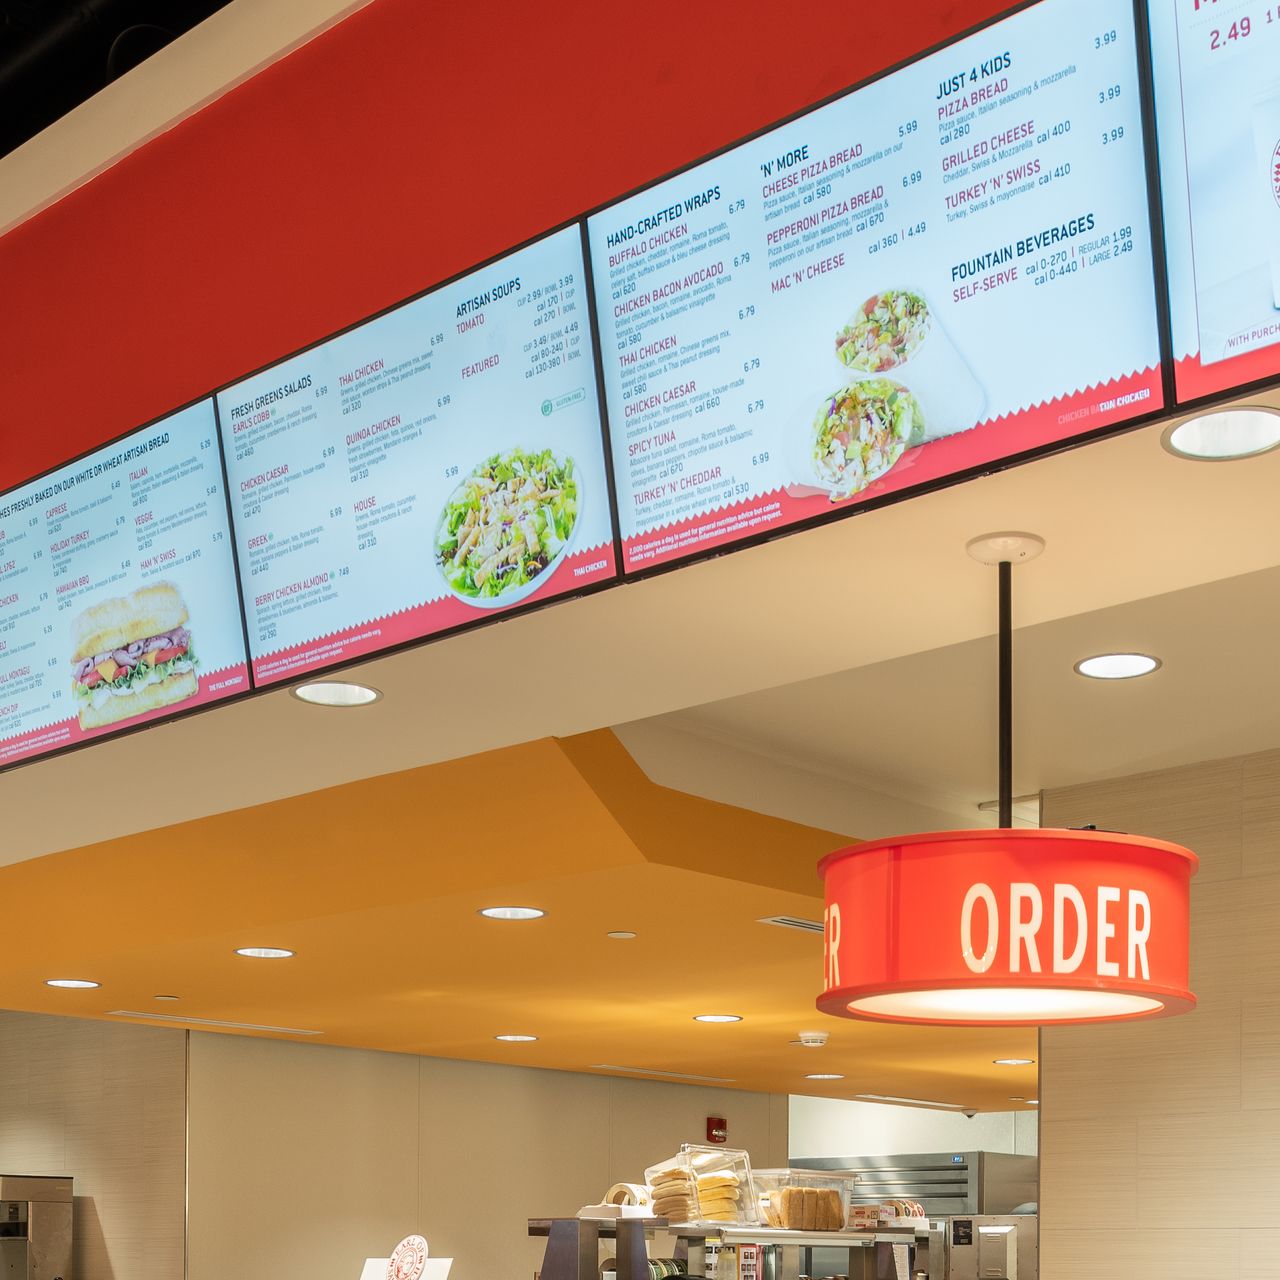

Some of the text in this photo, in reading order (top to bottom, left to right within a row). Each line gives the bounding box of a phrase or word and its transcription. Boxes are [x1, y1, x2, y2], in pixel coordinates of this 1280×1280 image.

[1210, 16, 1251, 50] 2.49
[1266, 10, 1273, 24] 1
[935, 50, 1011, 100] JUST 4 KIDS
[937, 29, 1117, 121] PIZZA BREAD 3.99
[761, 119, 918, 199] CHEESE PIZZA BREAD 5.99
[776, 144, 809, 172] MORE
[941, 84, 1121, 172] GRILLED CHEESE 3.99
[944, 180, 988, 211] TURKEY
[1005, 158, 1041, 185] SWISS
[1101, 125, 1124, 145] 3.99
[606, 184, 721, 250] HAND-CRAFTED WRAPS
[608, 198, 745, 268] BUFFALO CHICKEN 6.79
[766, 169, 922, 246] PEPPERONI PIZZA BREAD 6.99
[770, 274, 791, 294] MAC
[806, 251, 845, 279] CHEESE
[907, 221, 926, 238] 4.49
[950, 212, 1095, 282] FOUNTAIN BEVERAGES
[952, 225, 1132, 303] SELF-SERVE REGULAR 1.99
[1088, 239, 1133, 266] LARGE 2.49
[455, 277, 521, 318] ARTISAN SOUPS
[613, 251, 750, 319] CHICKEN BACON AVOCADO 6.79
[456, 312, 485, 335] TOMATO
[618, 304, 755, 368] THAI CHICKEN 6.79
[1227, 332, 1249, 348] WITH
[338, 332, 444, 387] THAI CHICKEN 6.99
[461, 353, 500, 379] FEATURED
[623, 357, 760, 418] CHICKEN CAESAR 6.79
[230, 373, 312, 421] FRESH GREENS SALADS
[232, 385, 328, 434] EARL'S COBB 6.99
[627, 398, 764, 457] SPICY TUNA 6.79
[10, 495, 34, 514] FRESHLY
[34, 486, 53, 503] BAKED
[53, 482, 62, 495] ON
[62, 475, 75, 491] OUR
[74, 467, 93, 485] WHITE
[93, 463, 102, 477] OR
[102, 453, 123, 473] WHEAT
[122, 442, 148, 463] ARTISAN
[148, 432, 170, 452] BREAD
[633, 484, 666, 506] TURKEY
[679, 465, 722, 491] CHEDDAR
[751, 451, 769, 466] 6.99
[959, 882, 1152, 981] ORDER
